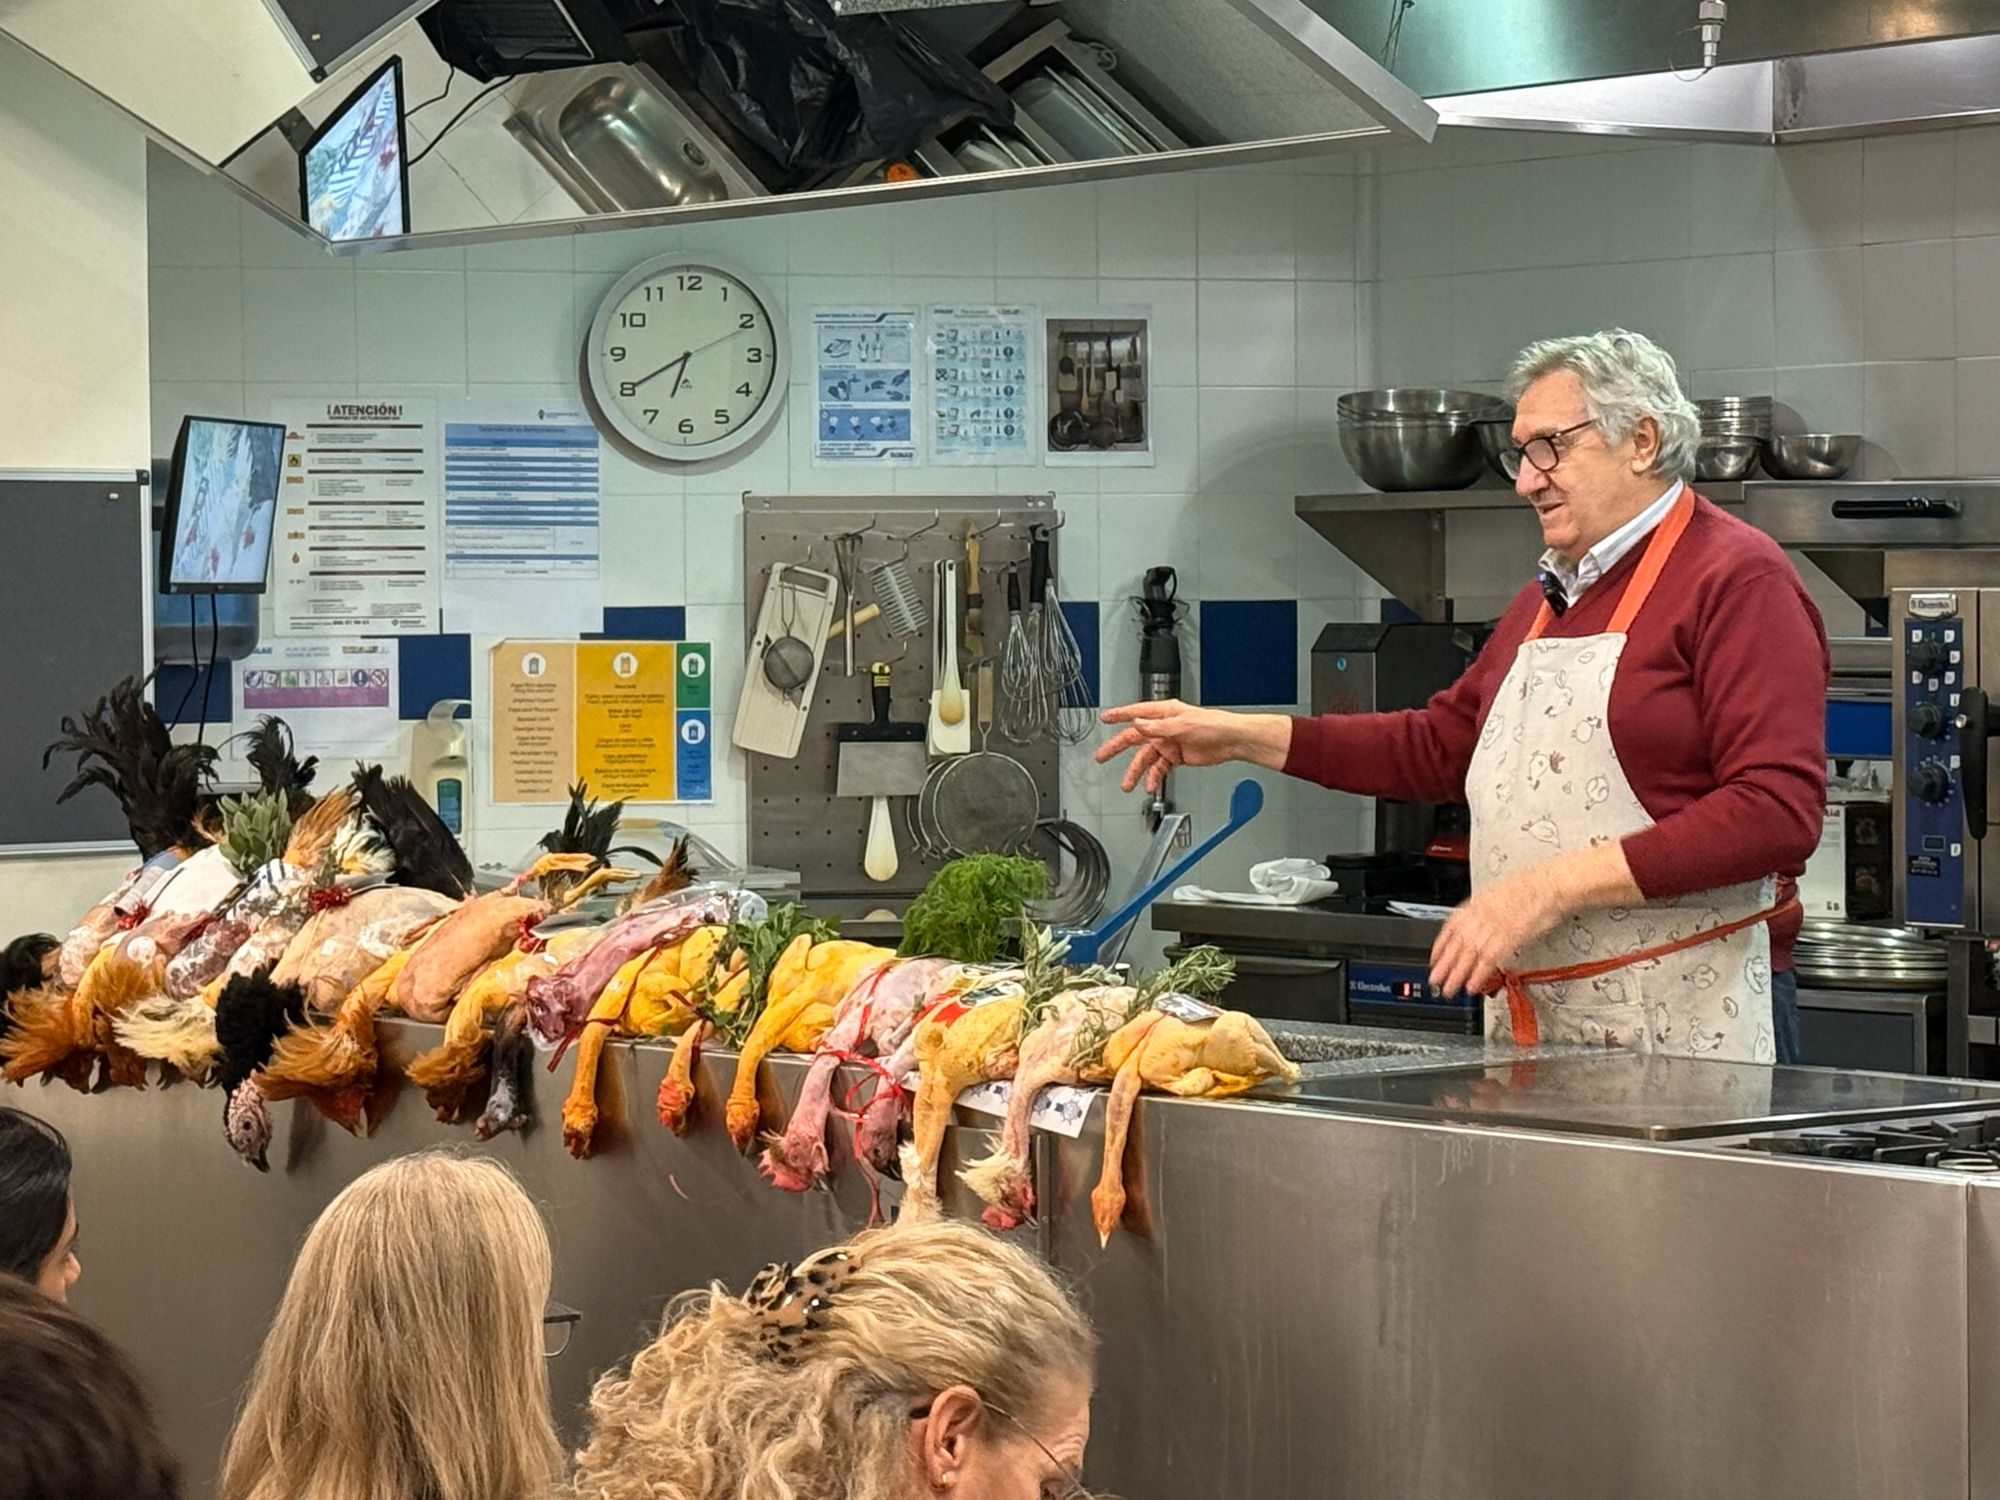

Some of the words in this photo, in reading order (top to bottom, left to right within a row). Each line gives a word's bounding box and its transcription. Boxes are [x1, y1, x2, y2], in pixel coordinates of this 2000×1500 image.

[676, 275, 703, 292] 12
[643, 286, 664, 302] 11
[721, 286, 728, 302] 1
[619, 312, 646, 328] 10
[738, 313, 755, 330] 2
[609, 346, 627, 363] 9
[746, 347, 763, 364] 3
[619, 381, 637, 397] 8
[735, 381, 753, 398] 4
[326, 401, 404, 416] ¡ATENCIÓN!
[642, 408, 660, 425] 7
[714, 409, 730, 425] 5
[678, 418, 694, 434] 6
[1357, 980, 1392, 993] Electrolux
